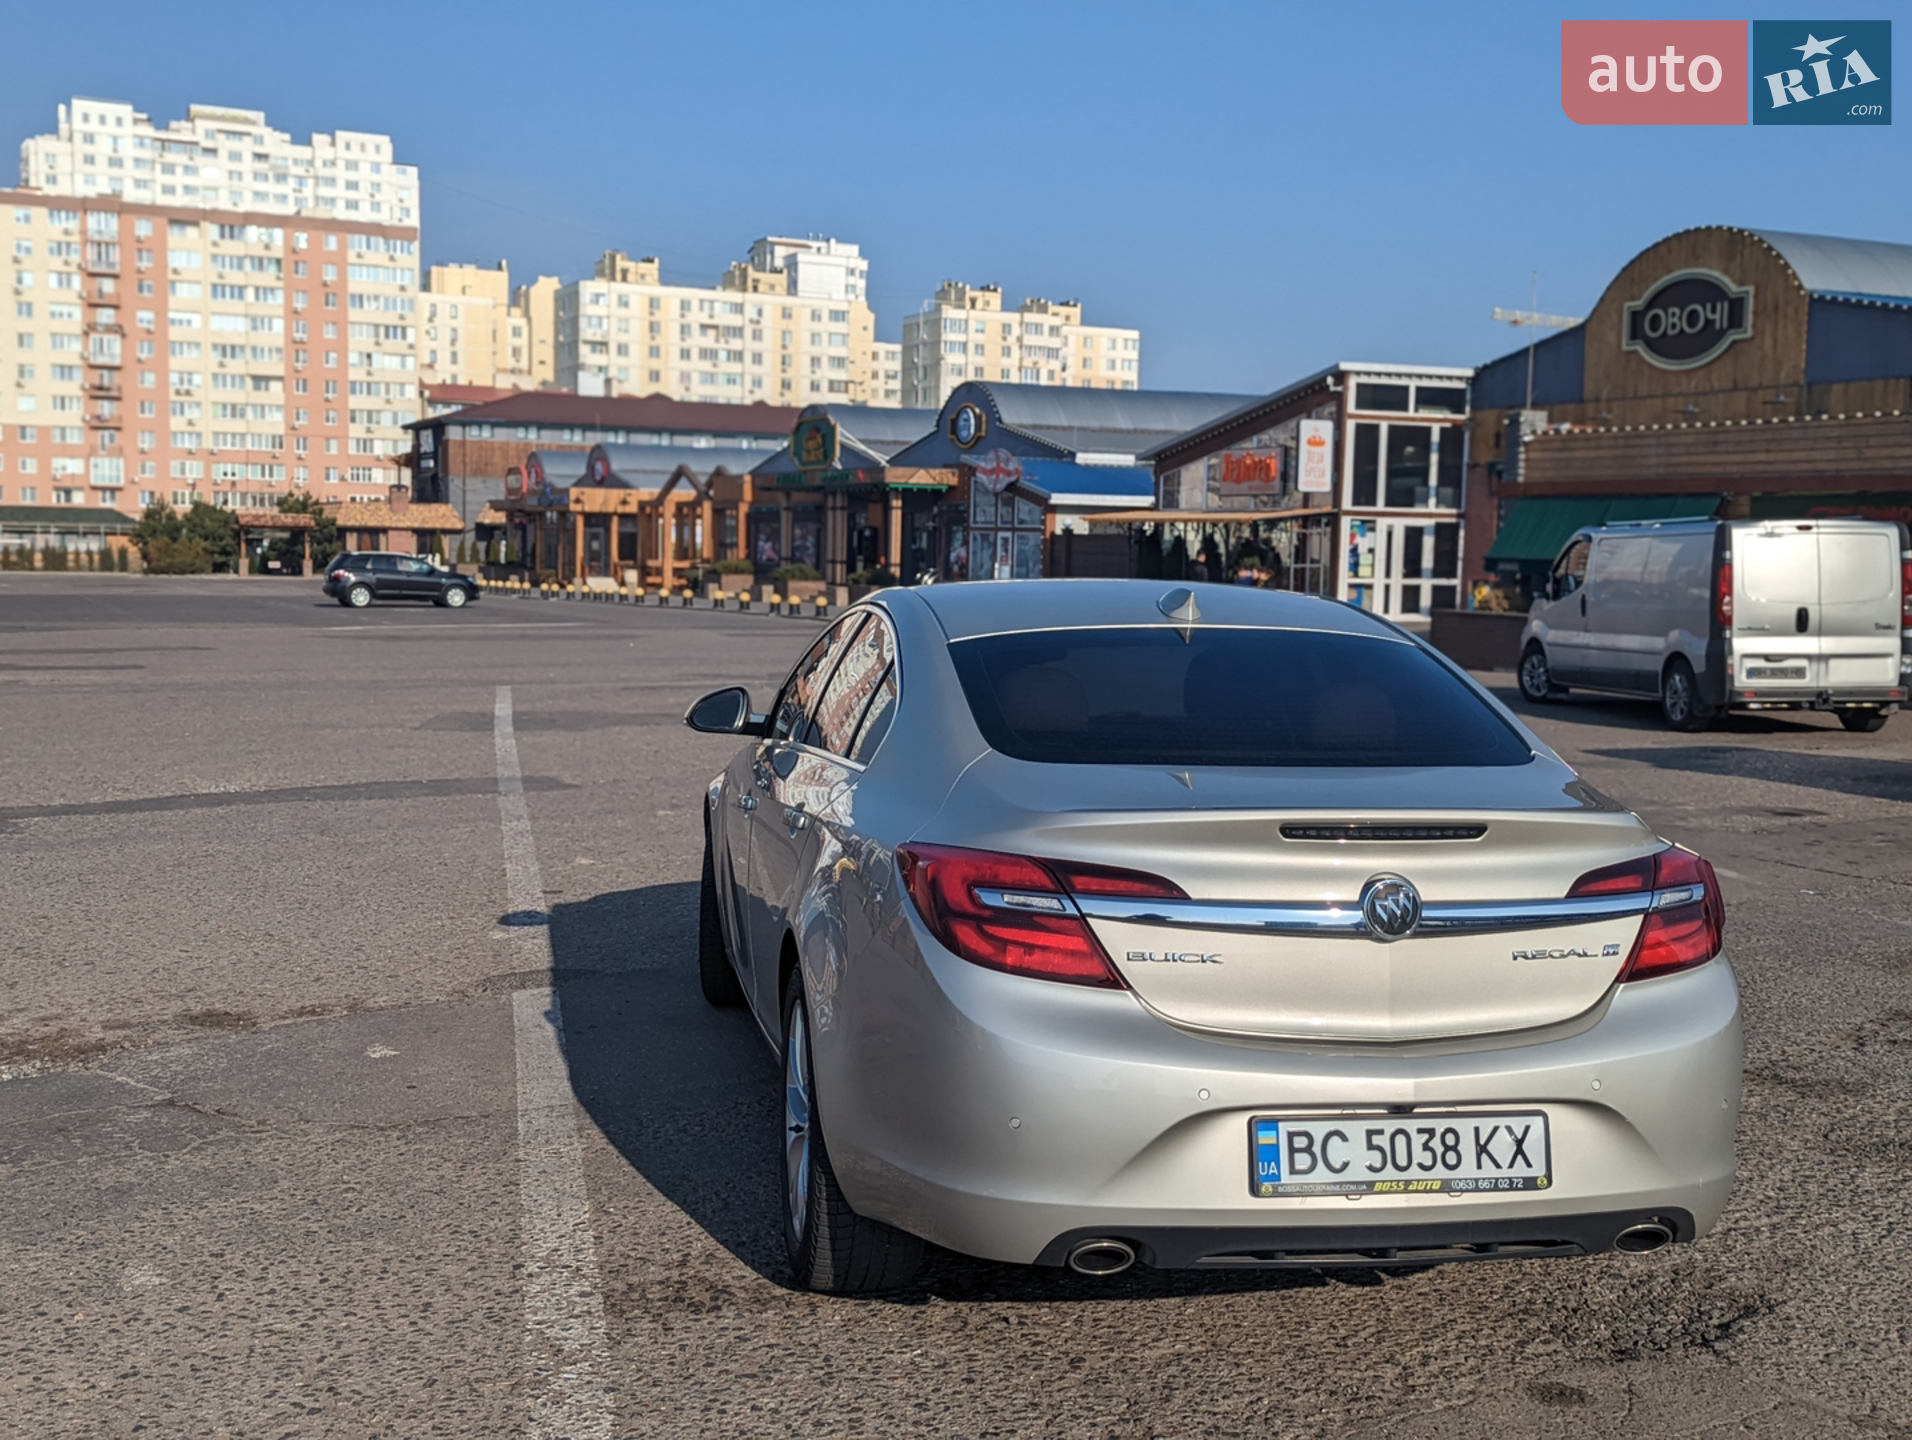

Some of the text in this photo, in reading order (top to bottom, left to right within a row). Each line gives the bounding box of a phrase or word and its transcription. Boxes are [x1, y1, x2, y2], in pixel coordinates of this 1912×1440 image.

[1644, 301, 1729, 338] ОВОЧІ
[1126, 951, 1224, 965] BUICK
[1512, 947, 1599, 961] REGAL
[1286, 1124, 1533, 1175] BC 5038 KX
[1258, 1161, 1279, 1176] UA
[1373, 1180, 1405, 1192] BOSS
[1407, 1180, 1442, 1191] AUTO
[1451, 1179, 1477, 1190] (063)
[1478, 1179, 1496, 1189] 667
[1497, 1178, 1510, 1189] 02
[1511, 1178, 1524, 1188] 72
